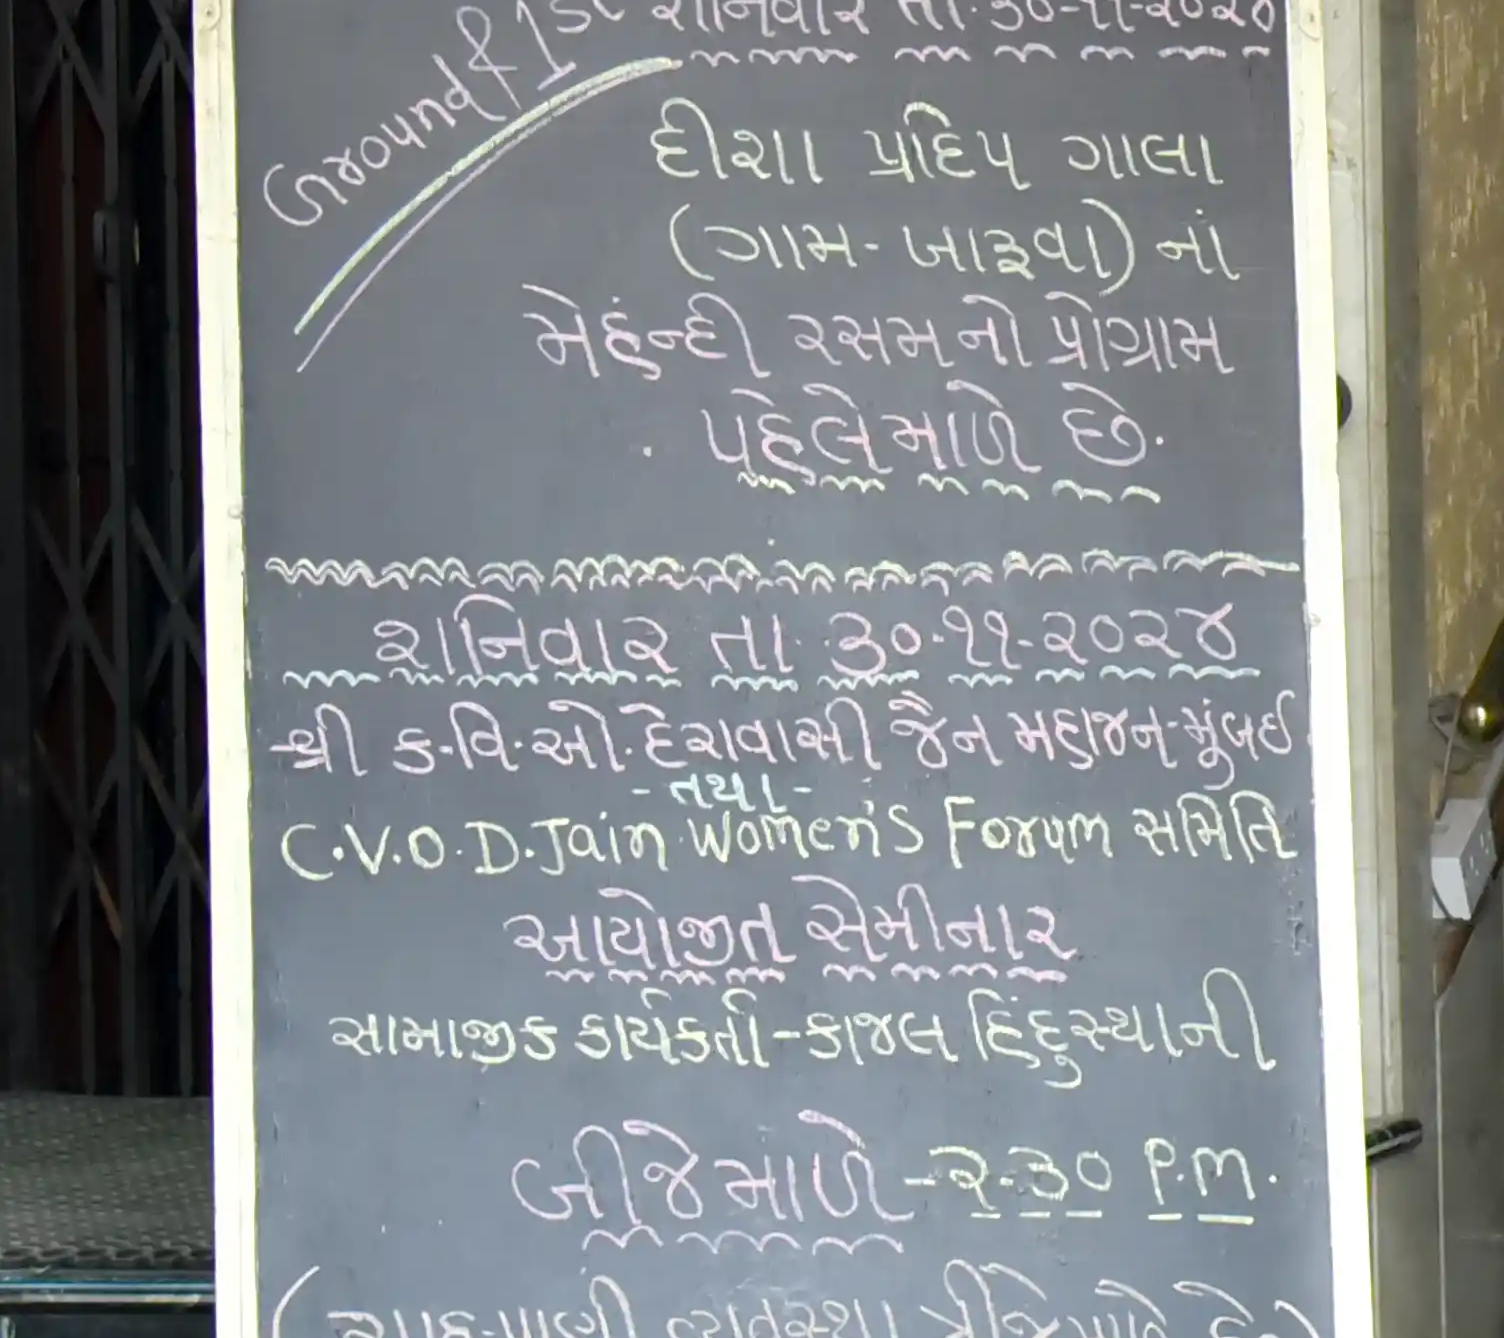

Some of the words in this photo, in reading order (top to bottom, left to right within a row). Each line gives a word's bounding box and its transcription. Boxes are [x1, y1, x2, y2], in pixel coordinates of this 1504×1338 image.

[263, 53, 507, 227] Ground
[649, 97, 824, 184] દીશા
[863, 101, 1032, 190] પ્રદિપ
[1062, 131, 1224, 187] ગાલા
[1155, 207, 1240, 280] નાં
[1045, 291, 1236, 376] પ્રોગ્રામ
[372, 594, 677, 675] શનિવાર
[269, 702, 368, 776] શ્રી
[889, 689, 1003, 768] જૈન
[943, 795, 1114, 870] Forum
[1132, 789, 1299, 863] સમિતિ
[504, 887, 798, 969] આયોજીત
[791, 874, 1077, 964] સેમીનાર
[329, 1011, 556, 1066] સામાજીક
[967, 968, 1279, 1089] હિંદુસ્થાની
